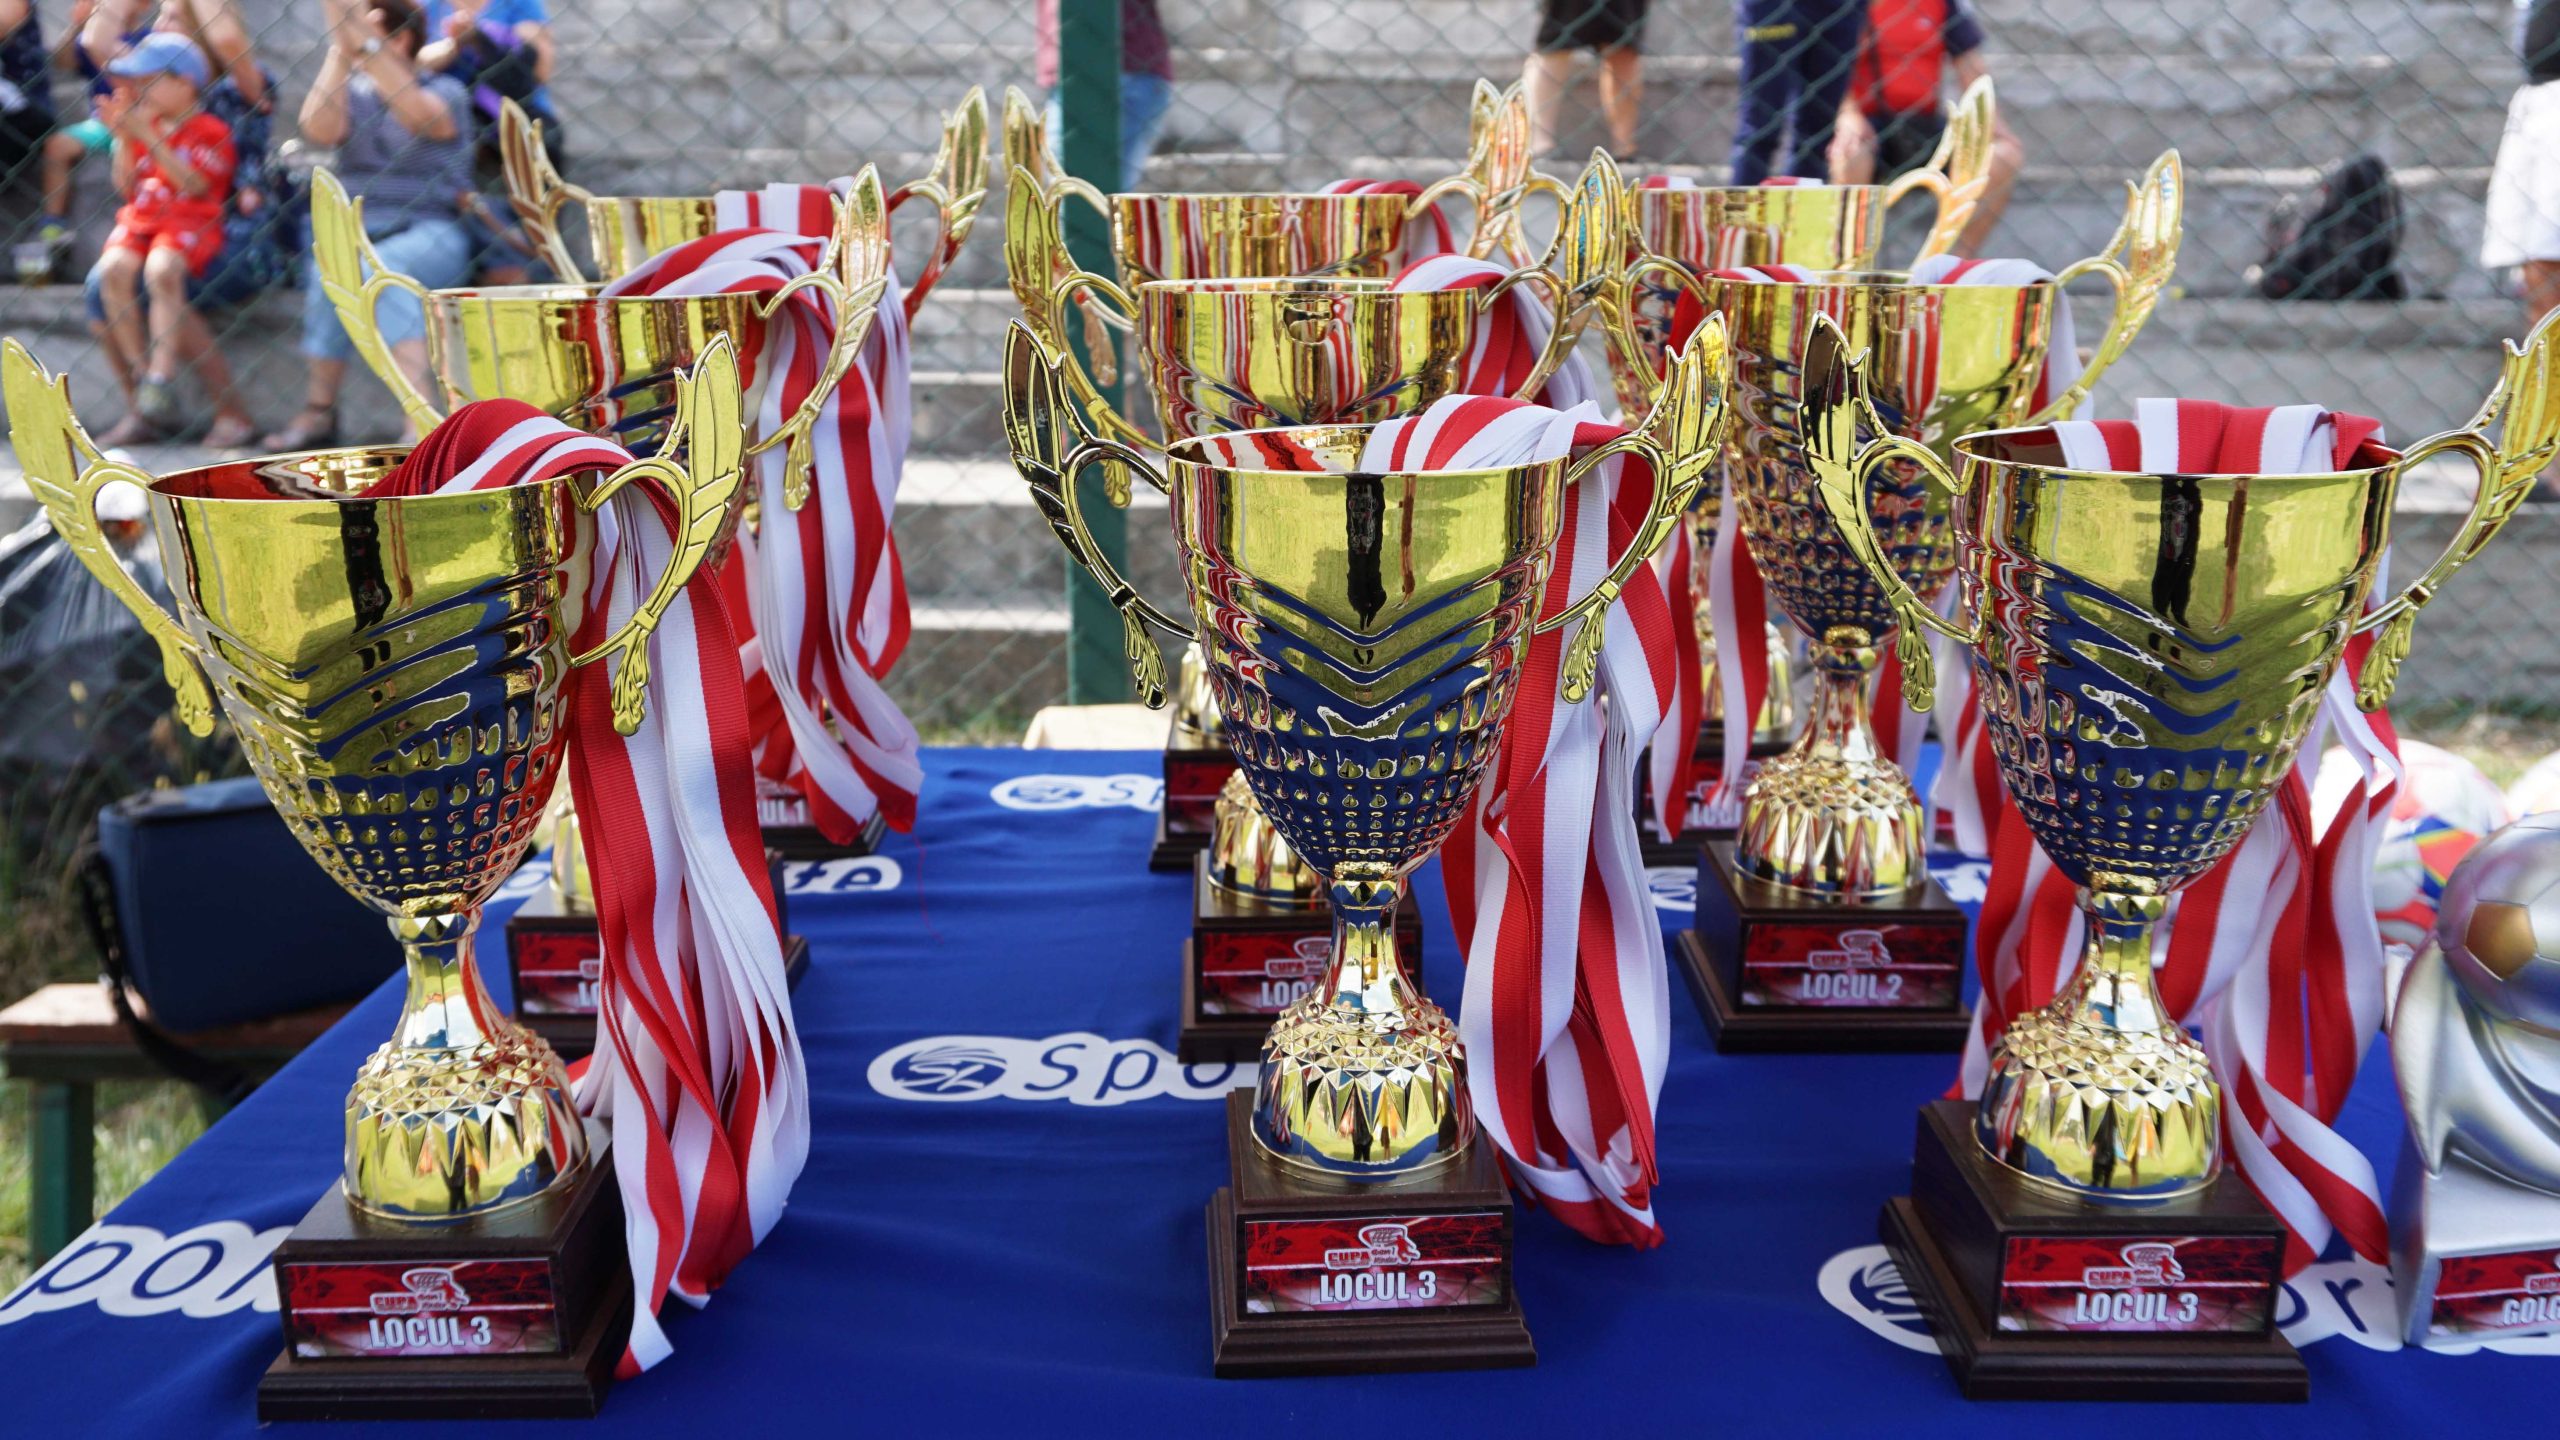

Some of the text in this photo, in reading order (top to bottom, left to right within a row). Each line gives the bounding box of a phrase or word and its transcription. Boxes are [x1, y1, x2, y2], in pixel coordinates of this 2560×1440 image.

[1261, 981, 1315, 1007] LOC
[1802, 973, 1903, 1000] LOCUL 2
[1024, 1043, 1236, 1100] Spo
[1320, 1270, 1437, 1302] LOCUL 3
[2076, 1292, 2199, 1322] LOCUL 3
[368, 1316, 491, 1348] LOCUL 3
